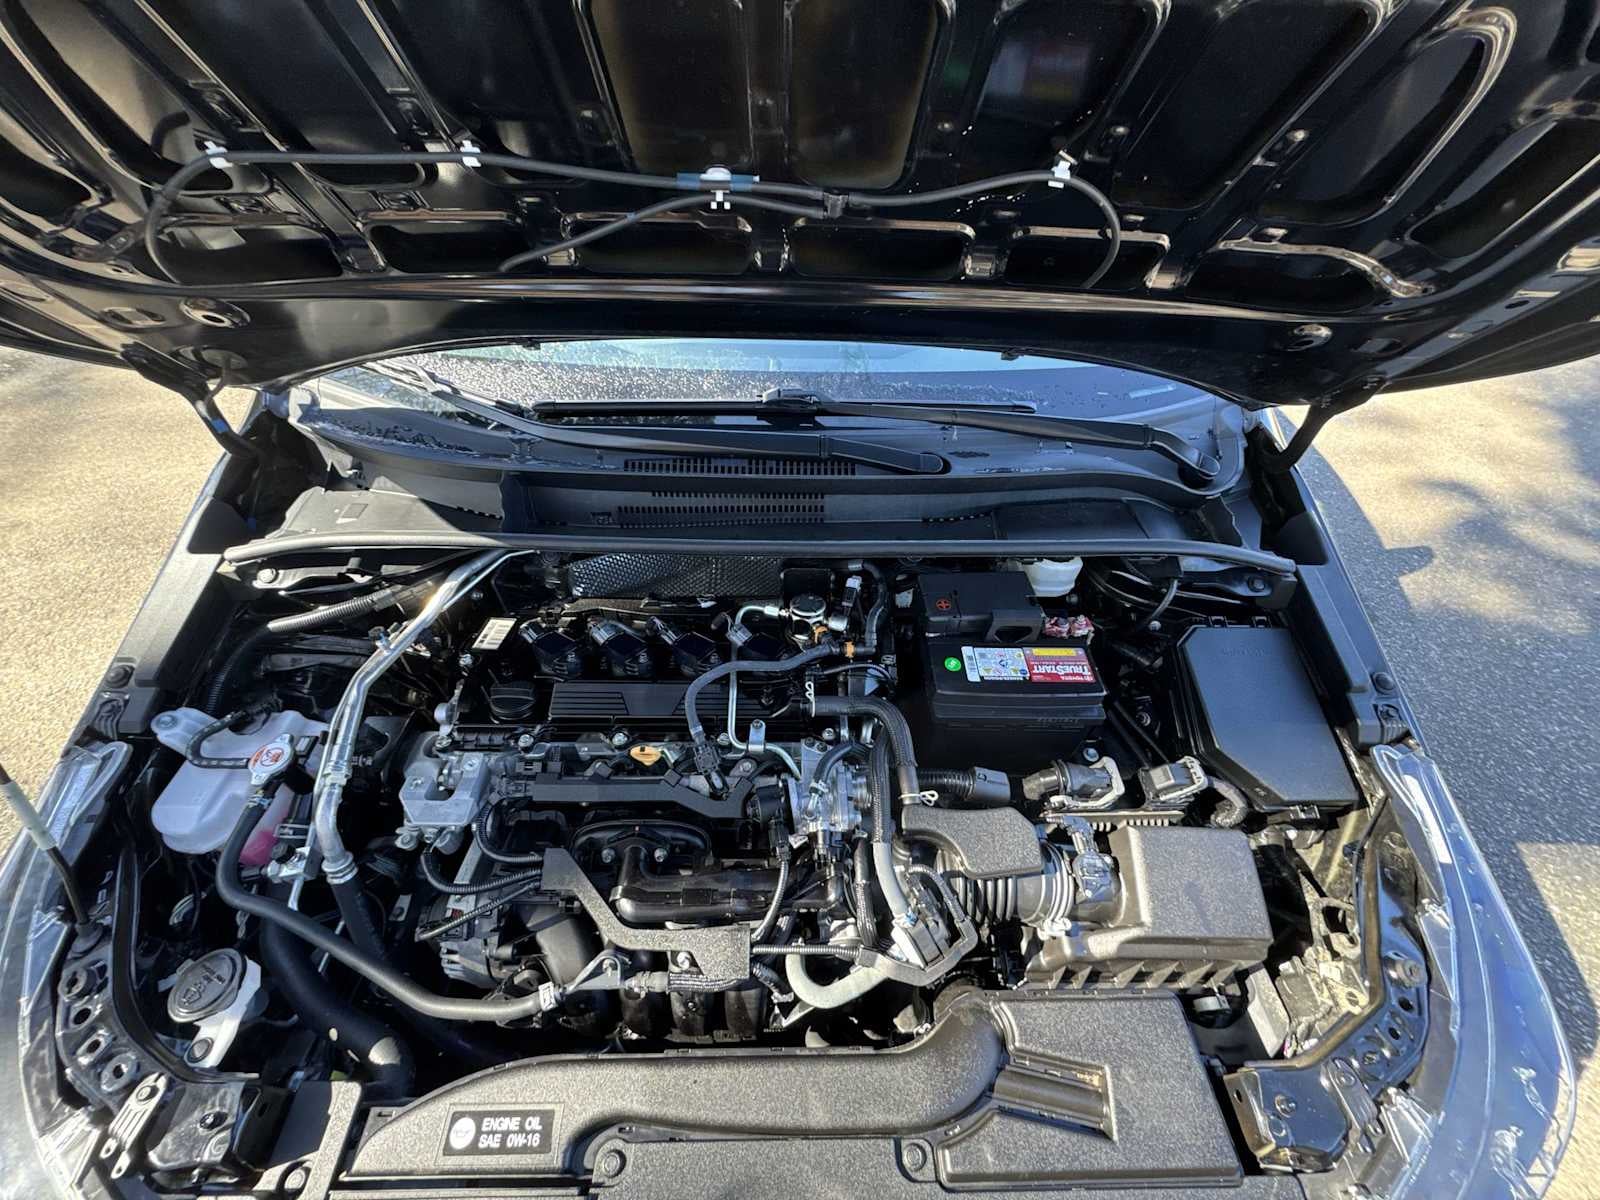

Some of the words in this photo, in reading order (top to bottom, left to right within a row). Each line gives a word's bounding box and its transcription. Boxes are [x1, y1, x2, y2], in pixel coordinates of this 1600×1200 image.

[481, 1117, 520, 1131] ENGINE
[524, 1116, 542, 1131] OIL
[478, 1134, 501, 1148] SAE
[506, 1133, 540, 1147] 0W-16
